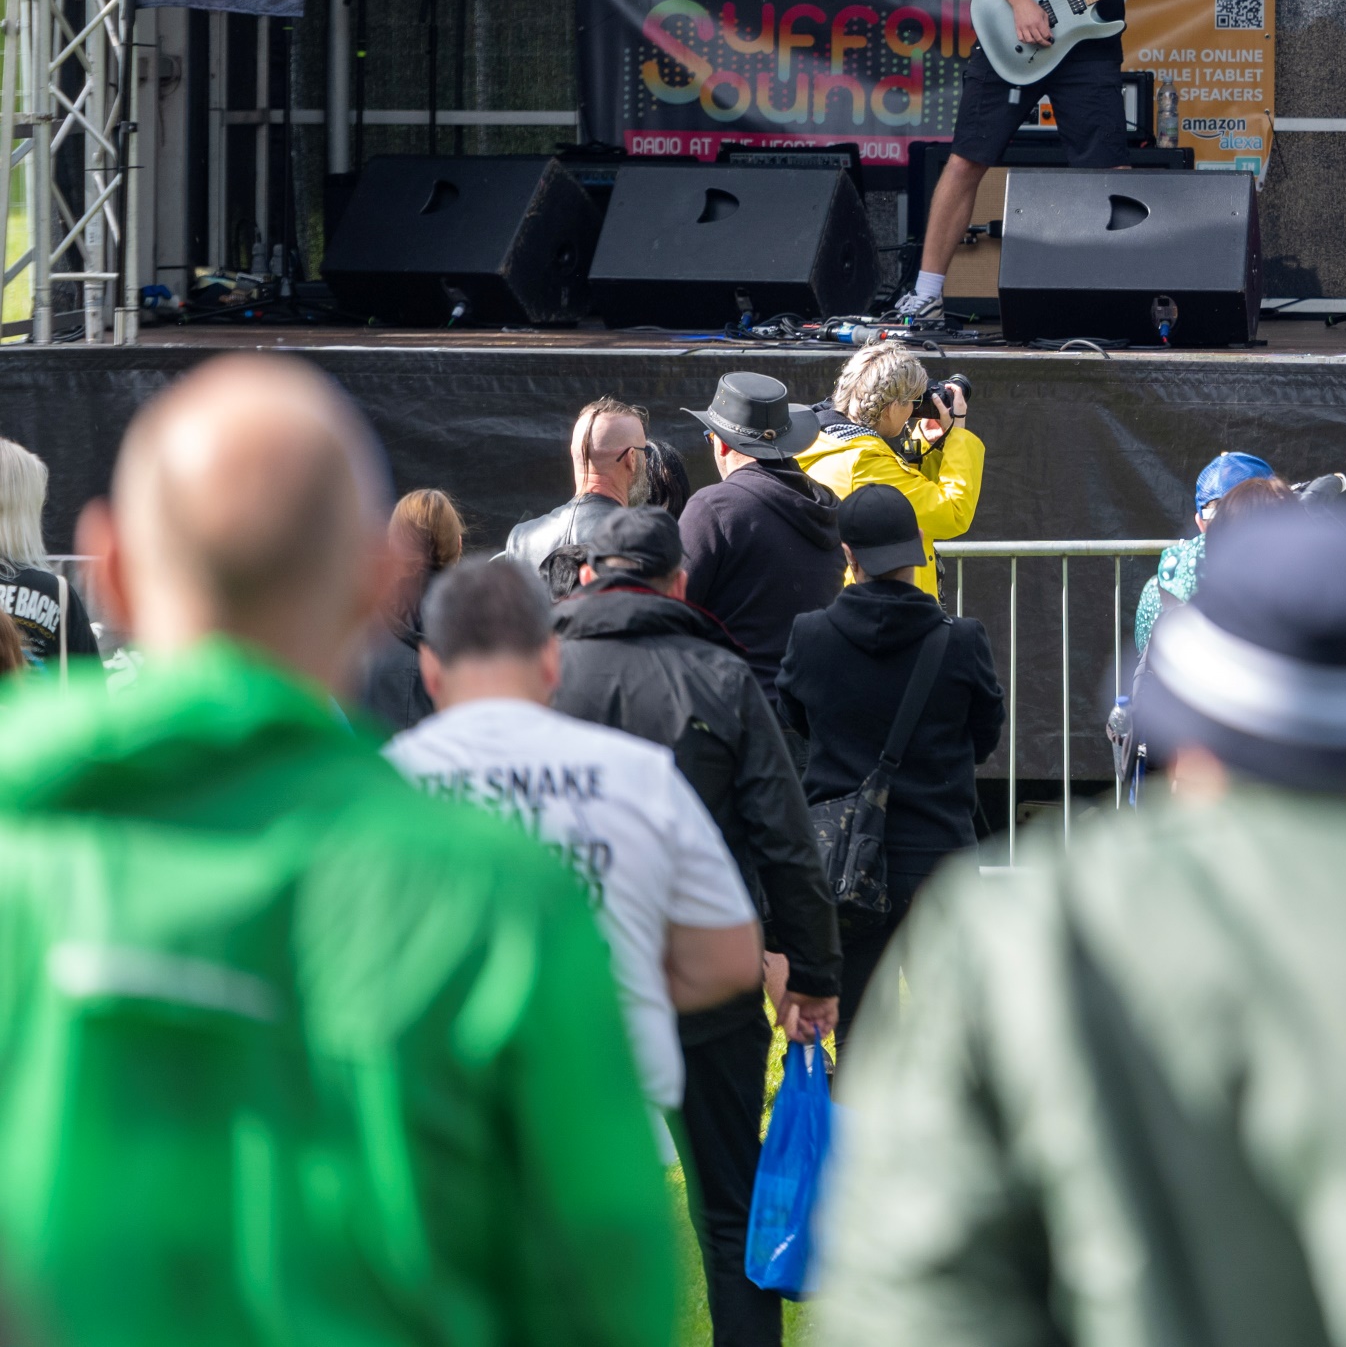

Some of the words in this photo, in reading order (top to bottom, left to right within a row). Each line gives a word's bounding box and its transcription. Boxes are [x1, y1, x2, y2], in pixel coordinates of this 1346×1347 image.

[1138, 48, 1165, 63] ON
[1168, 49, 1197, 63] AIR
[1200, 49, 1264, 63] ONLINE
[1128, 68, 1191, 82] OBILE
[1203, 68, 1264, 82] TABLET
[1180, 88, 1264, 102] SPEAKERS
[1182, 117, 1247, 131] amazon
[632, 135, 681, 155] RADIO
[689, 137, 711, 154] AT
[1219, 132, 1263, 150] alexa
[485, 764, 603, 801] SNAKE
